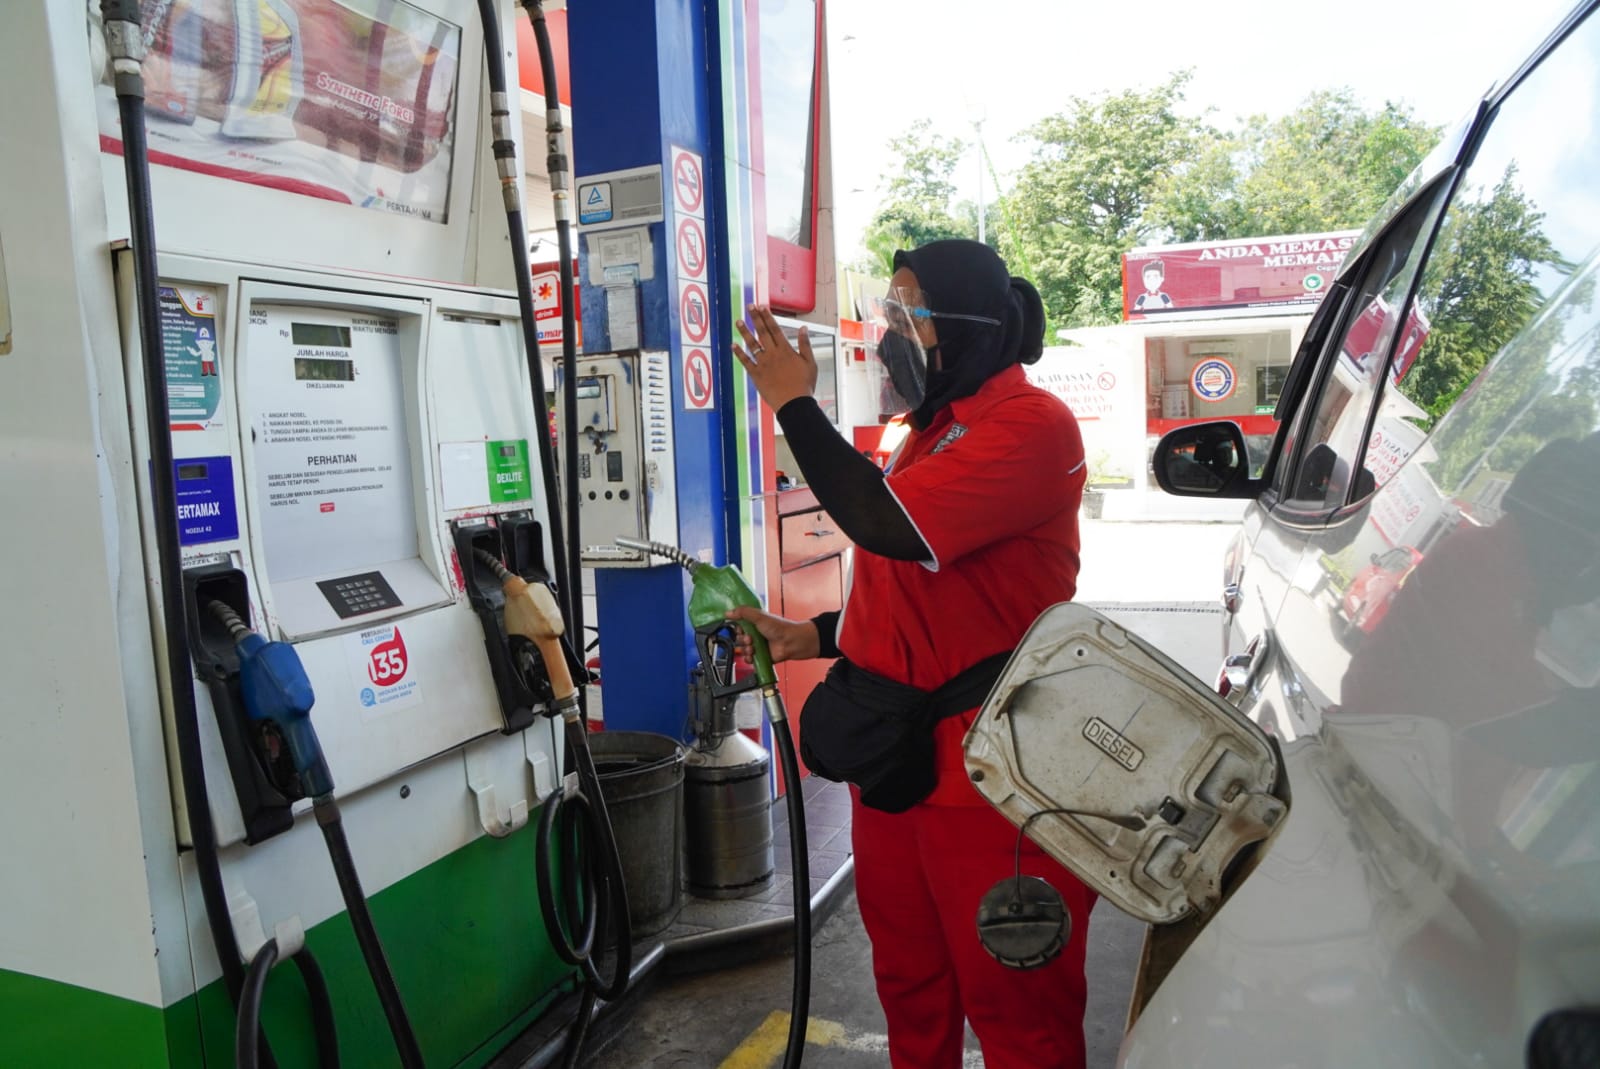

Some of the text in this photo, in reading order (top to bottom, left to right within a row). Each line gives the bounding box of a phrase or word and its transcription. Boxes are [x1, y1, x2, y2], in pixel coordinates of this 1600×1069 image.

[1198, 245, 1264, 261] ANDA
[279, 329, 289, 338] Rp
[296, 349, 349, 358] JUMLAH HARGA
[307, 454, 358, 466] PERHATIAN
[369, 647, 404, 681] 135
[1087, 721, 1136, 768] DIESEL
